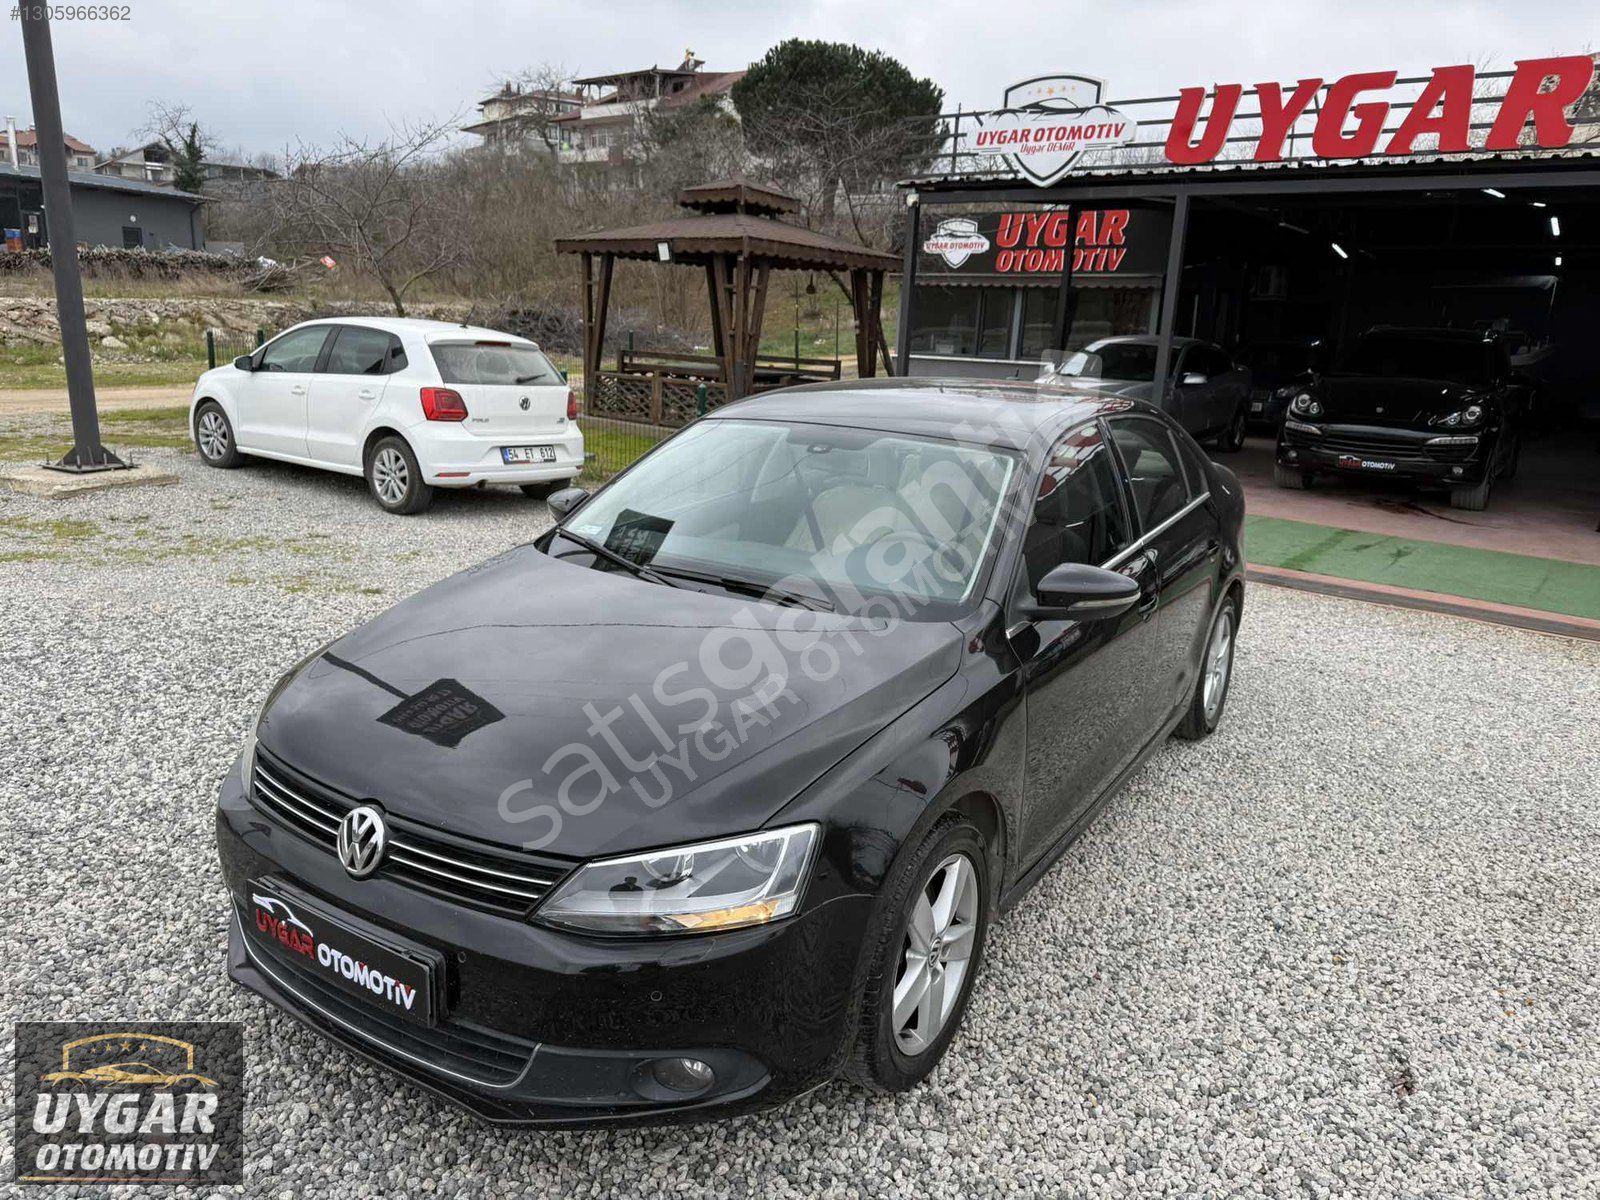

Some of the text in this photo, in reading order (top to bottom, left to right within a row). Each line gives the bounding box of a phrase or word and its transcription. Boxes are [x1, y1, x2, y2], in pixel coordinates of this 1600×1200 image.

[1164, 55, 1595, 165] UYGAR
[976, 128, 1031, 146] UYGAR
[995, 209, 1130, 247] UYGAR
[508, 447, 554, 460] 54 ET 612
[255, 908, 315, 960] UYGAR
